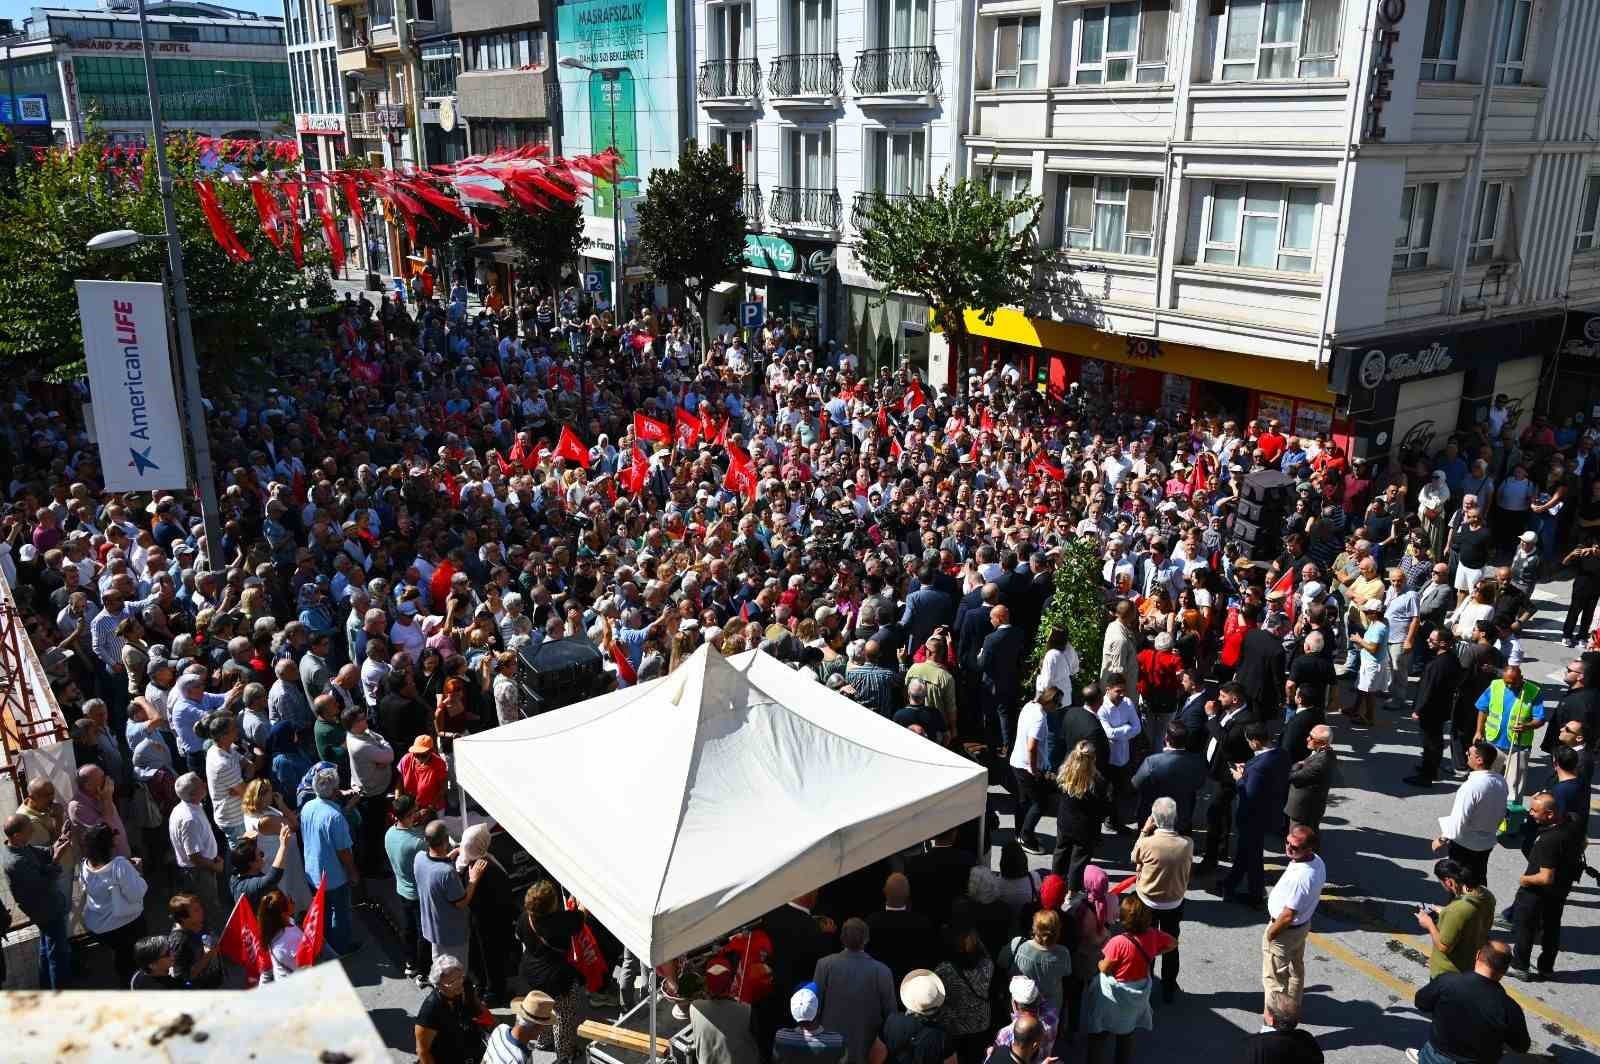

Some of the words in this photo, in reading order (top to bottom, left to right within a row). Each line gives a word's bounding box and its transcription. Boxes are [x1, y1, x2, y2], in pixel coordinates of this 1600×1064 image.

[578, 4, 642, 25] MASRAFSIZLIK
[159, 43, 192, 53] HOTEL
[745, 304, 758, 322] P
